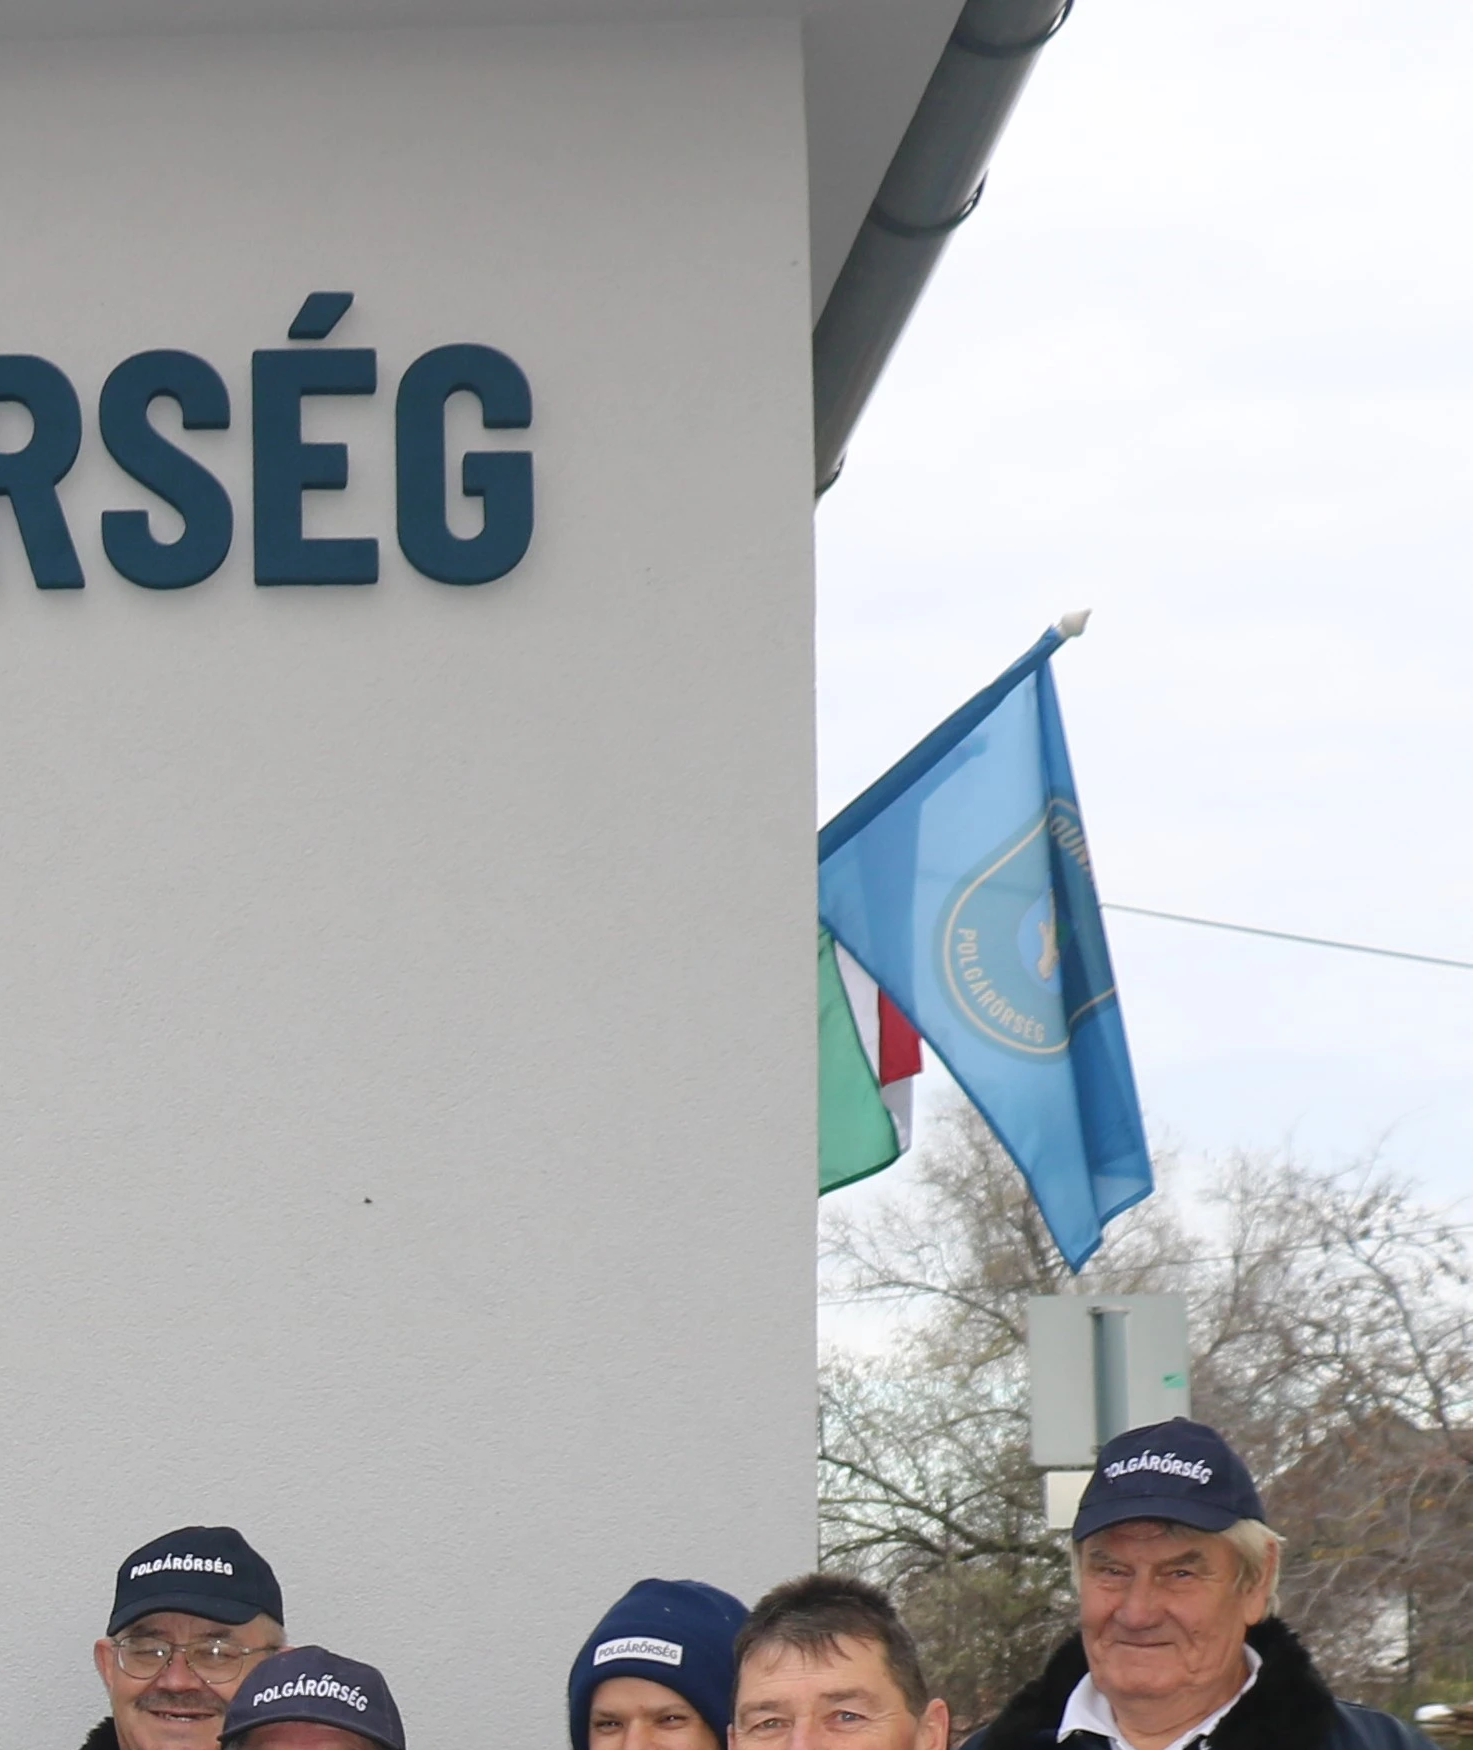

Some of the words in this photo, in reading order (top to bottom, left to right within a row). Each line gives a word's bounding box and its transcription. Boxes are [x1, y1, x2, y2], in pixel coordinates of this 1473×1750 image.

[129, 1552, 234, 1580] POLGÁRŐRSÉG
[598, 1640, 679, 1660] POLGÁRŐRSÉG
[253, 1673, 368, 1713] POLGÁRŐRSÉG
